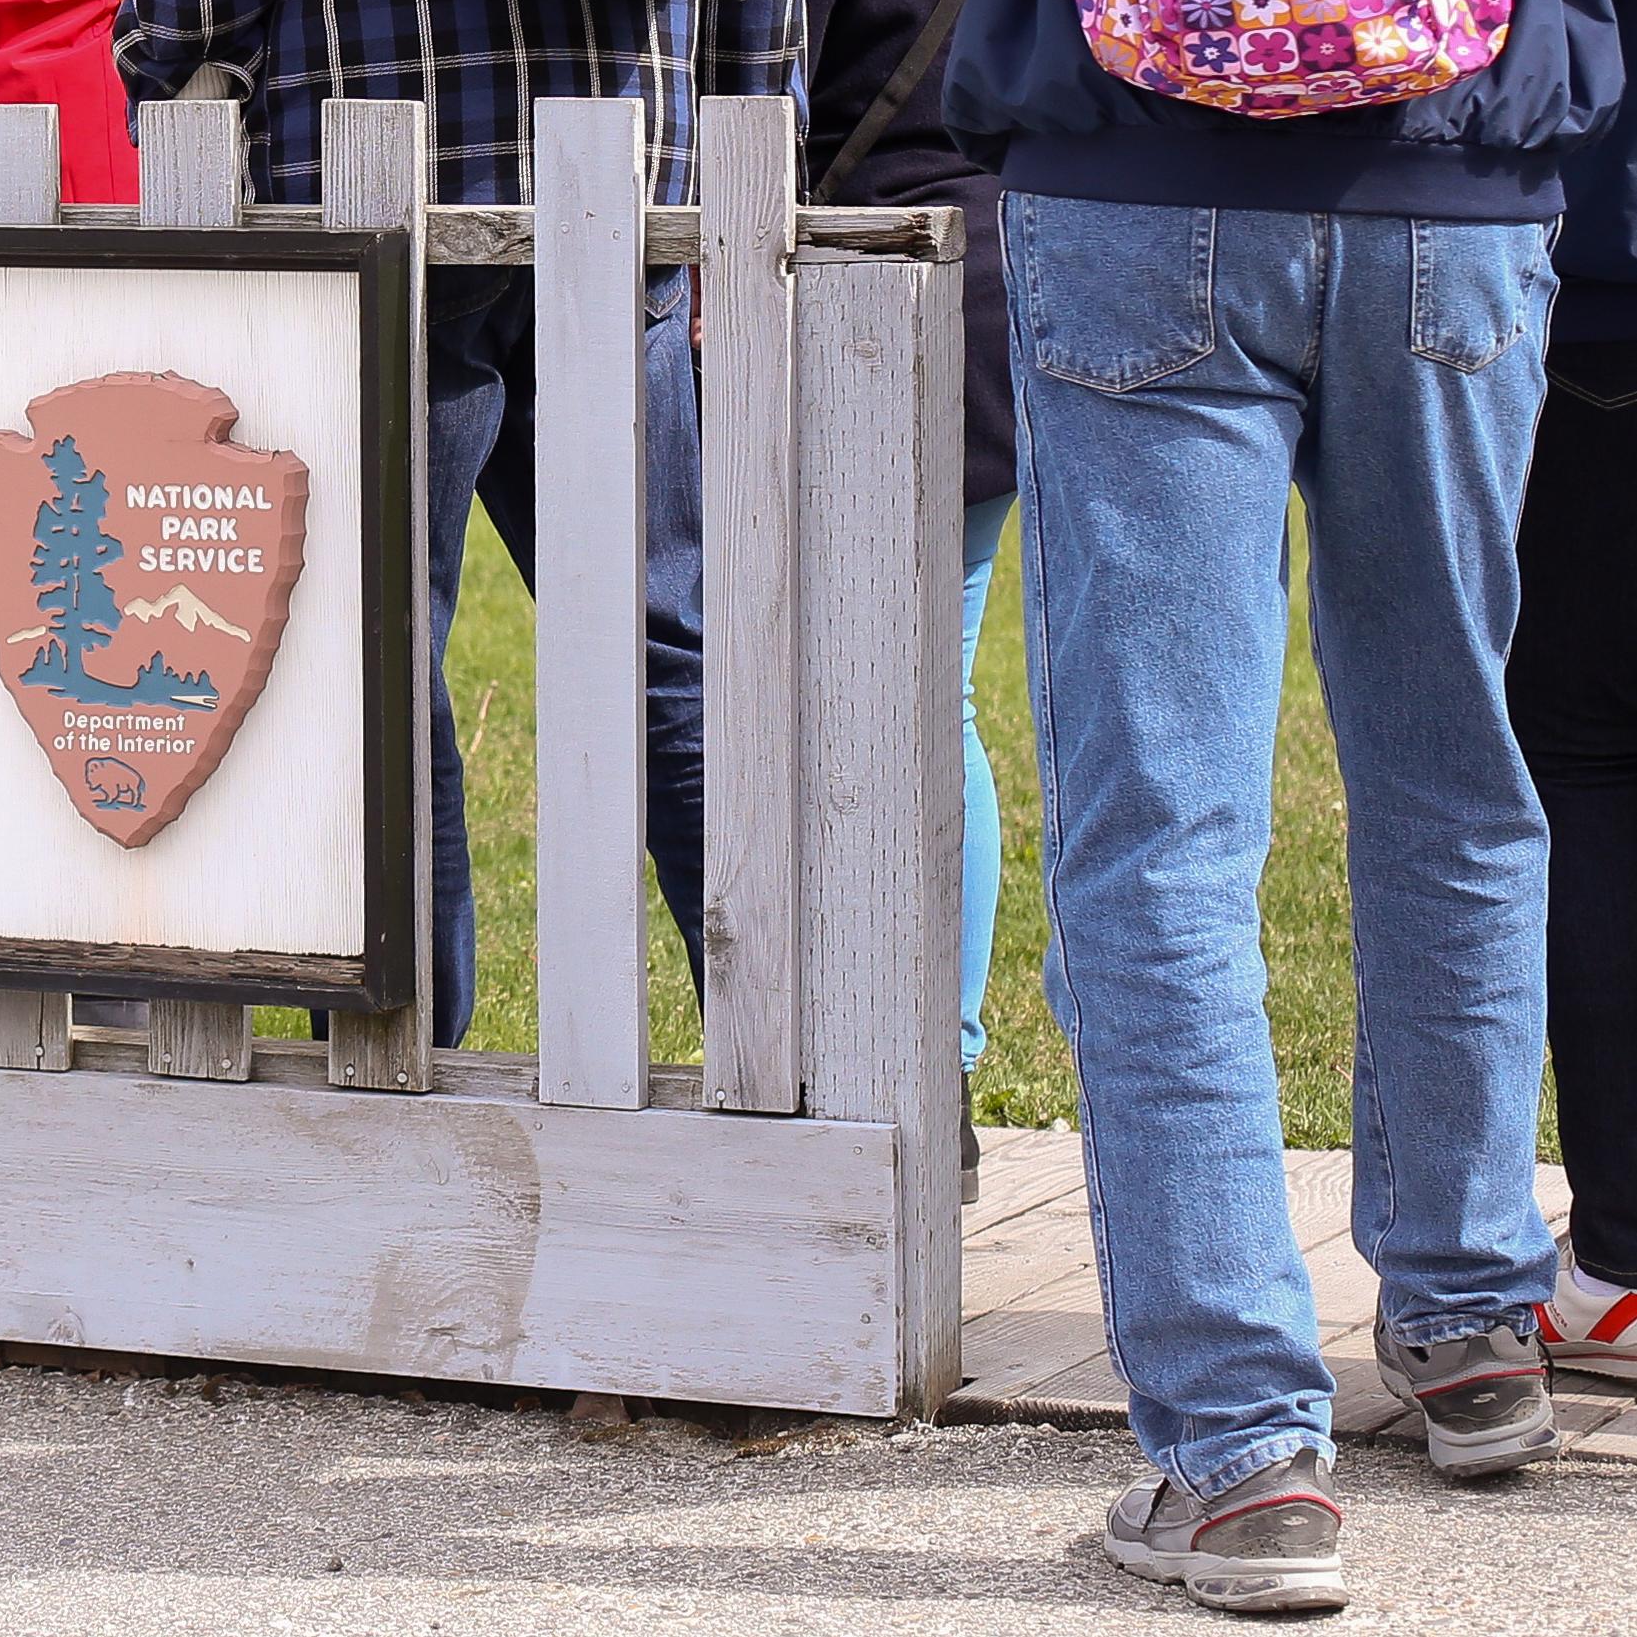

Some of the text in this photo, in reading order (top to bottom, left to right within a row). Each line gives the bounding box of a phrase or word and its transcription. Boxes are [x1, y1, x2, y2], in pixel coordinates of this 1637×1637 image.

[126, 483, 272, 510] NATIONAL
[162, 516, 238, 541] PARK
[138, 545, 264, 573] SERVICE
[64, 711, 185, 733] Department
[53, 731, 196, 754] of the Interior
